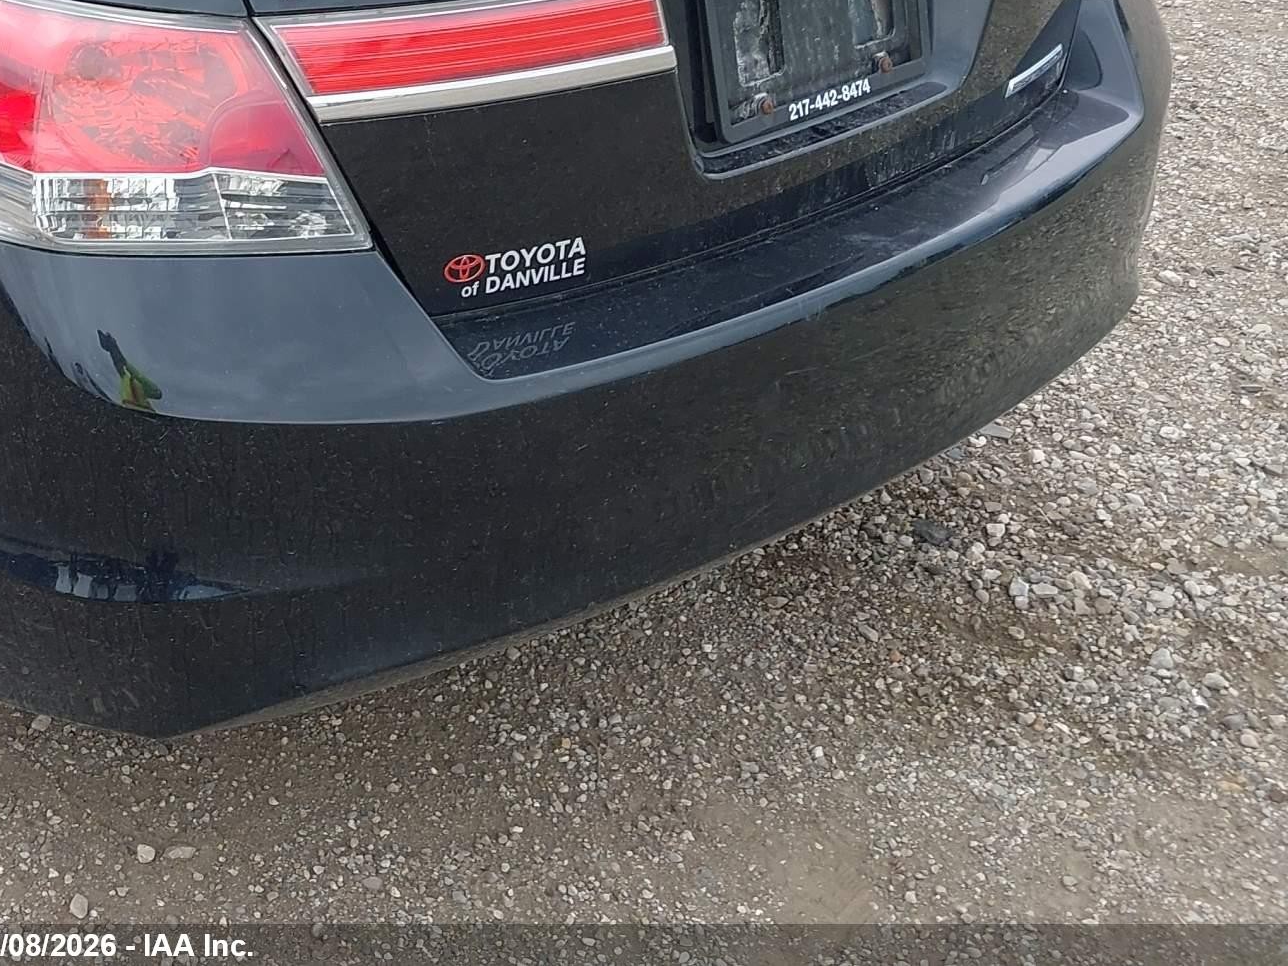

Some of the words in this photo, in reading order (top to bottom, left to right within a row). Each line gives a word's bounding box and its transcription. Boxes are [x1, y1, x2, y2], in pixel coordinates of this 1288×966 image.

[788, 78, 871, 121] 217-442-8474
[485, 236, 586, 274] TOYOTA
[461, 281, 480, 298] of
[485, 257, 586, 294] DANVILLE
